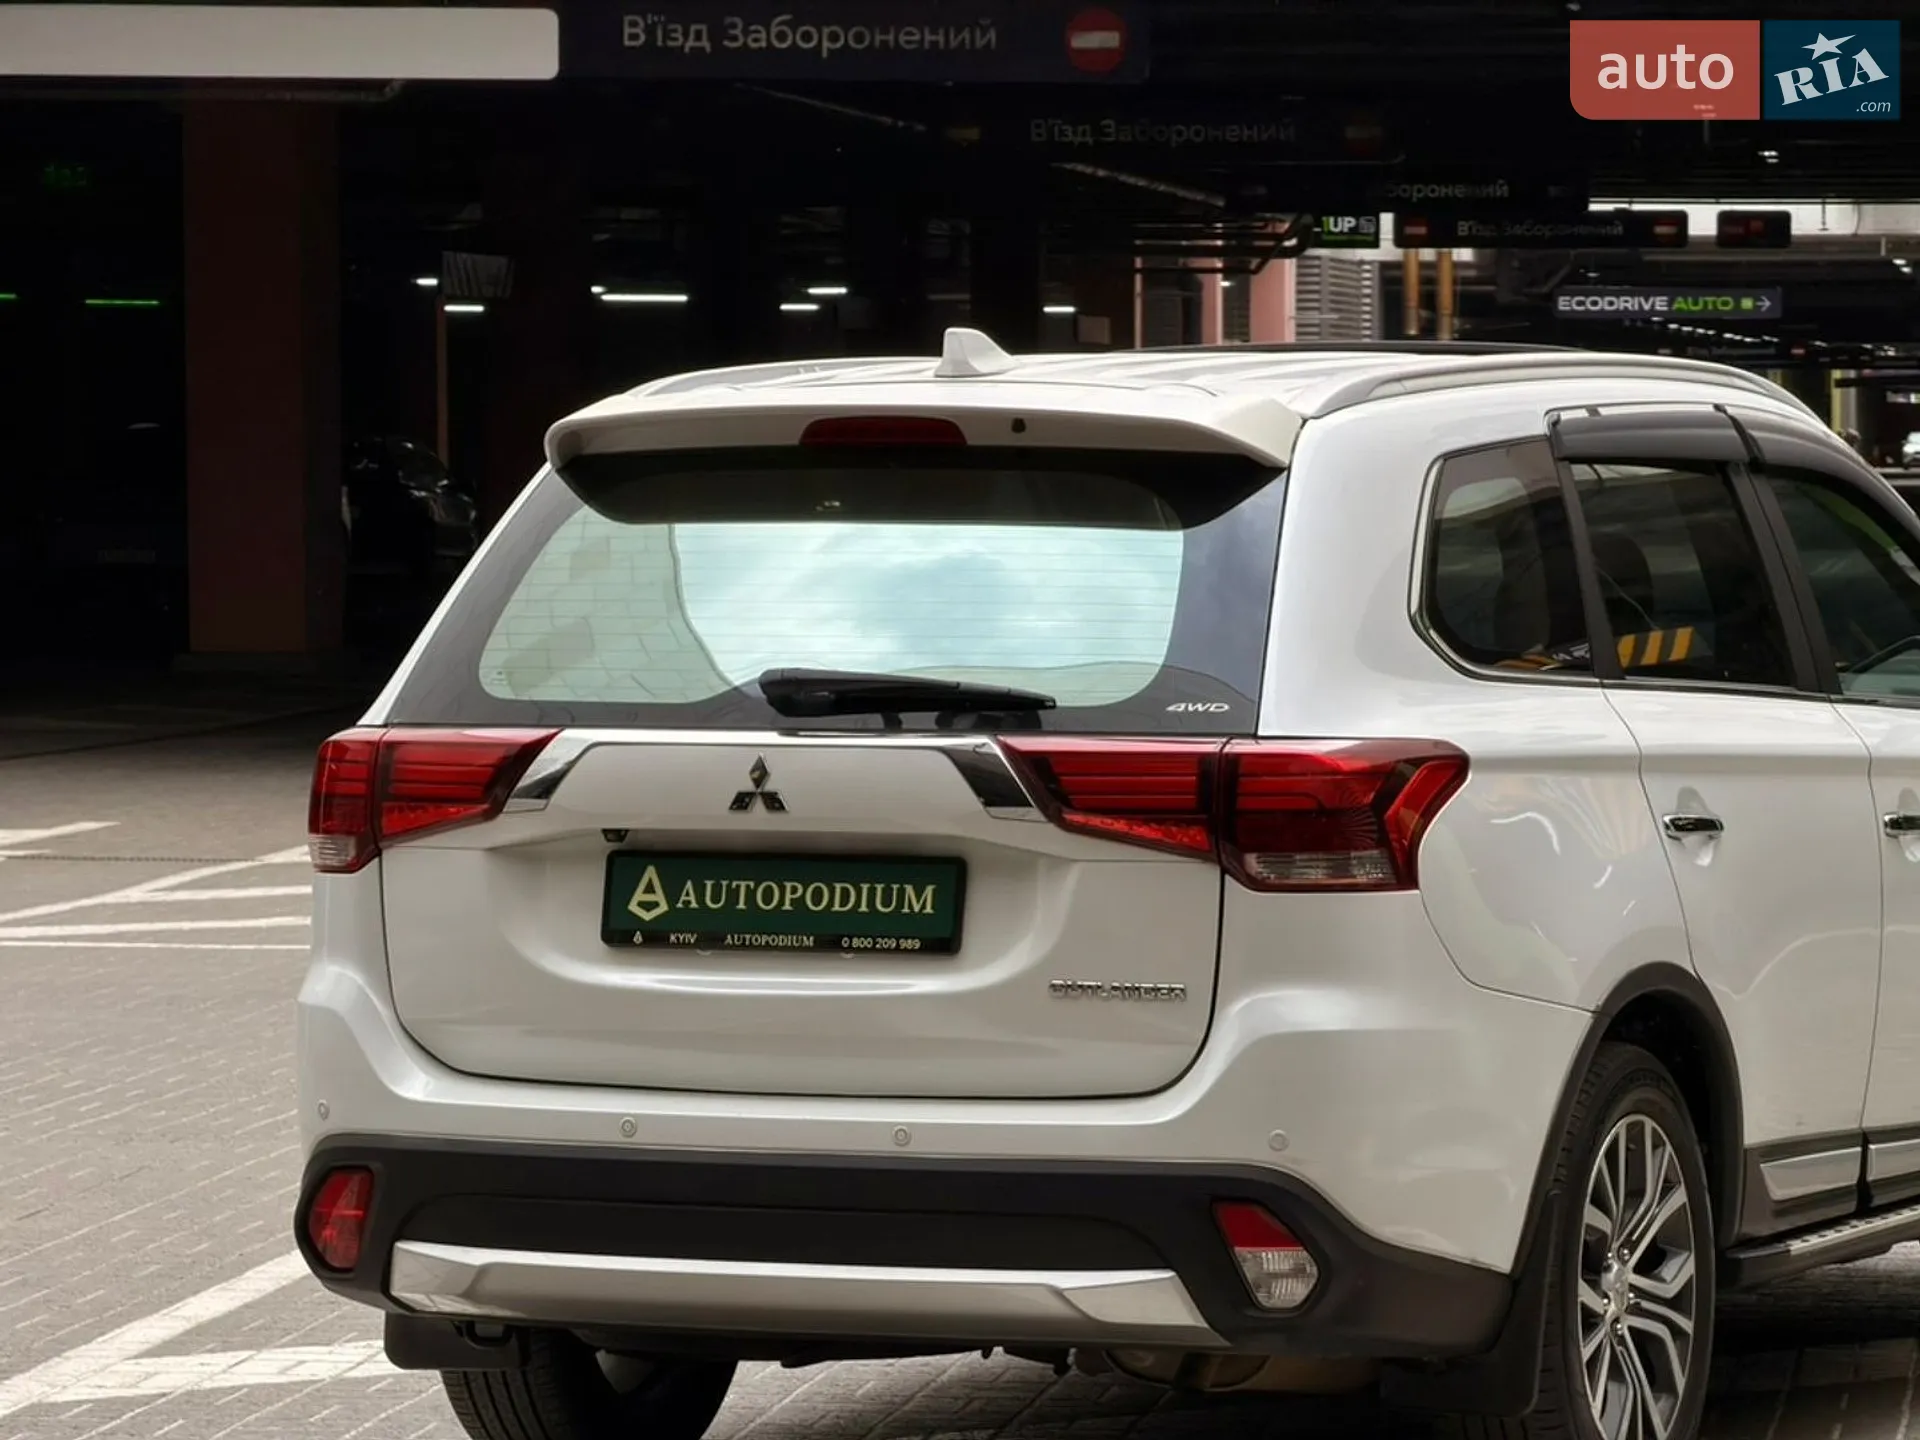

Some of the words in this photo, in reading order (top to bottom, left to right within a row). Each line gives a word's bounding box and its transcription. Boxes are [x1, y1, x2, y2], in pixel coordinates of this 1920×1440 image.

[722, 14, 997, 58] Заборонений
[1557, 295, 1669, 312] ECODRIVE
[1671, 296, 1735, 312] AUTO
[1165, 702, 1231, 713] 4WD
[675, 879, 937, 915] AUTOPODIUM
[668, 932, 698, 945] KYIV
[724, 933, 816, 948] AUTOPODIUM
[1049, 979, 1188, 1001] OUTLANDER
